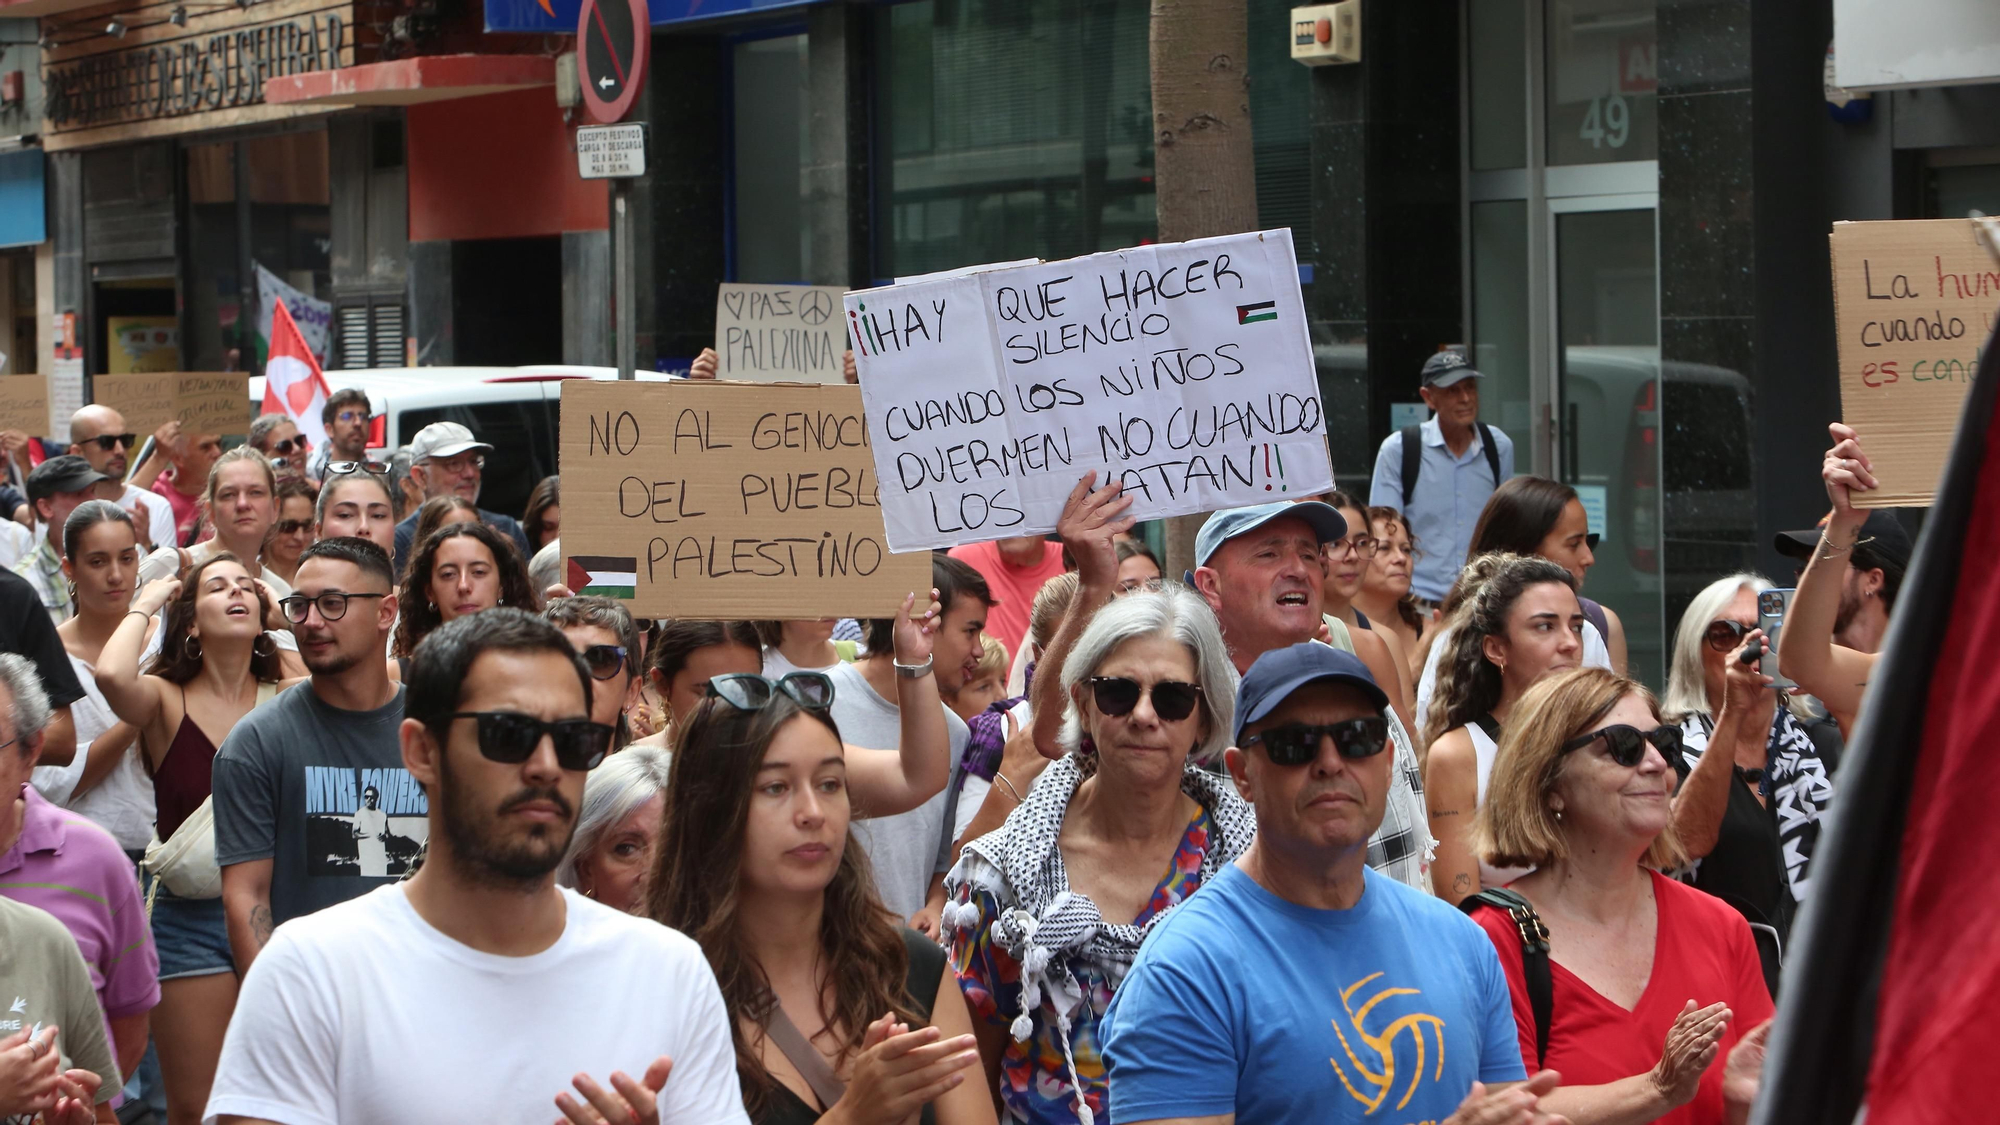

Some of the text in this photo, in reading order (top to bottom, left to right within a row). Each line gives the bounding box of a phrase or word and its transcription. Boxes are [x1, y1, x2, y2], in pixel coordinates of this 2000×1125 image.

[579, 129, 640, 142] EXCEPTO FESTIVOS
[1580, 95, 1629, 149] 49
[579, 140, 642, 153] CARGA Y DESCARGA
[592, 153, 600, 163] DE
[997, 276, 1073, 323] QUE
[1100, 254, 1243, 311] HACER
[1864, 259, 1919, 300] La
[727, 327, 836, 374] PALESTINA
[1861, 310, 1965, 347] cuando
[103, 378, 170, 398] TRUMP
[1863, 361, 1899, 388] es
[590, 411, 640, 456] NO
[674, 408, 732, 454] AL
[886, 389, 1005, 441] CUANDO
[1016, 379, 1084, 413] LOS
[897, 392, 1319, 493] DUERMEN NO CUANDO
[619, 467, 880, 523] DEL PUEBL
[929, 489, 1025, 532] LOS
[305, 766, 358, 814] MYKE
